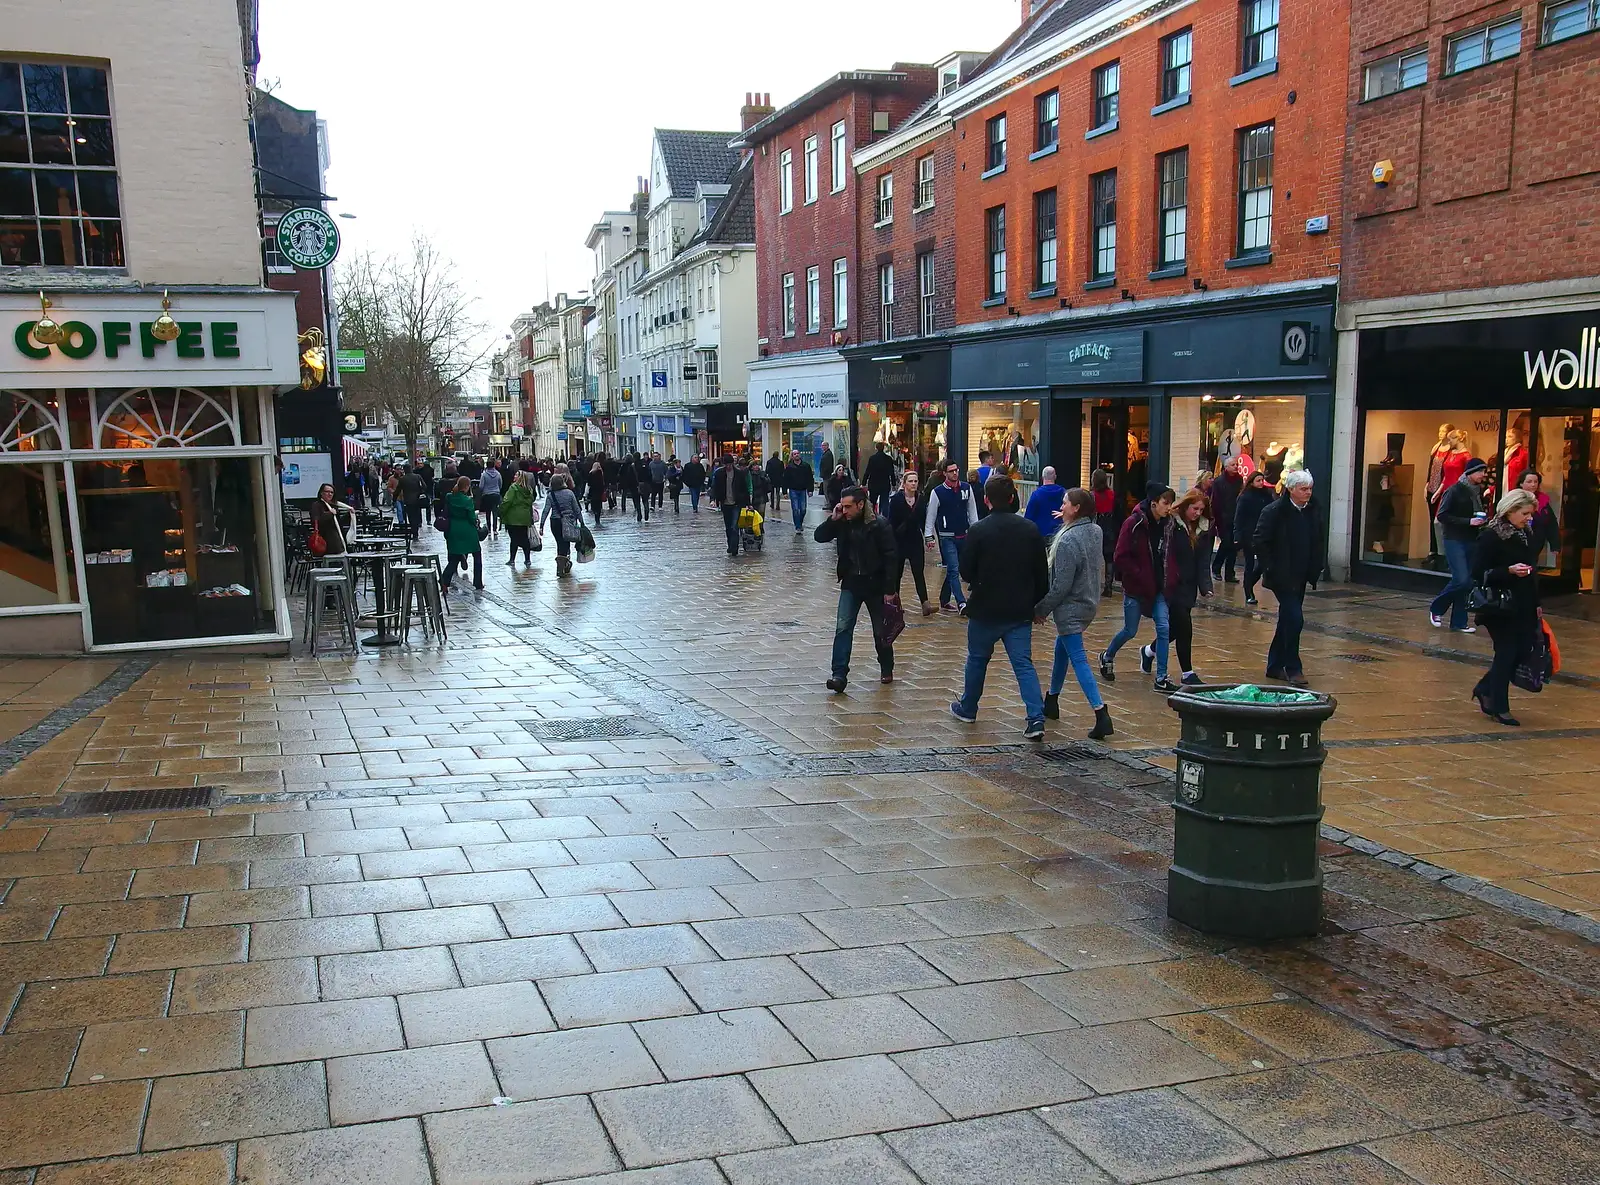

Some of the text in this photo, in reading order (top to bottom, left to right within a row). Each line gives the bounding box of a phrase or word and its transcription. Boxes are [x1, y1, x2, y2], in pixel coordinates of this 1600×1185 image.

[281, 210, 336, 238] STARBUCKS
[288, 248, 331, 265] COFFEE
[14, 320, 241, 360] COFFEE
[1068, 343, 1111, 363] FATFACE
[764, 388, 823, 414] Optical Expre
[344, 414, 358, 431] 3
[1474, 415, 1500, 432] wallis
[960, 489, 969, 500] M
